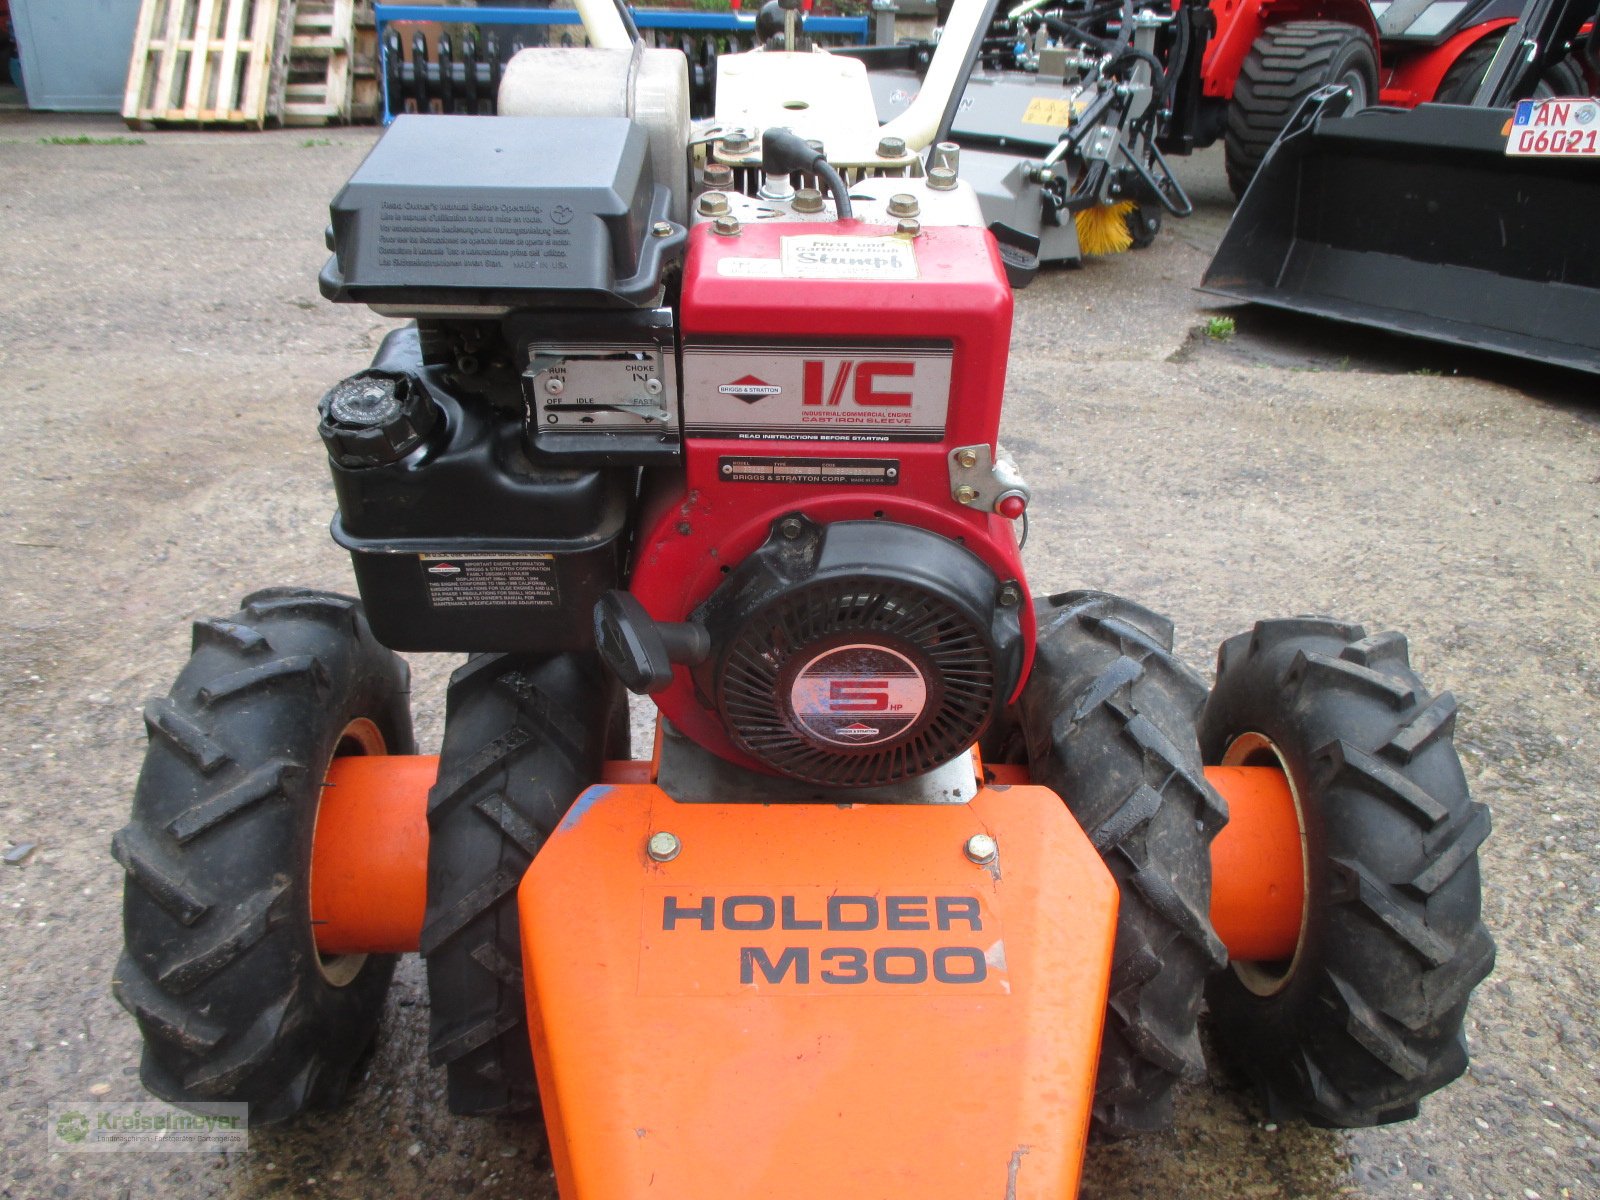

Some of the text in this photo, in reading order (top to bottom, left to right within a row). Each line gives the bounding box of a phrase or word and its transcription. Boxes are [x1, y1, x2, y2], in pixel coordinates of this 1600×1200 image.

[1518, 116, 1525, 124] D
[1534, 103, 1571, 126] AN
[1518, 130, 1597, 153] 06021
[625, 364, 655, 372] CHOKE
[802, 360, 916, 408] I/C
[762, 433, 819, 441] INSTRUCTIONS
[829, 680, 903, 711] 5 HP
[662, 895, 983, 932] HOLDER
[740, 946, 988, 985] M300
